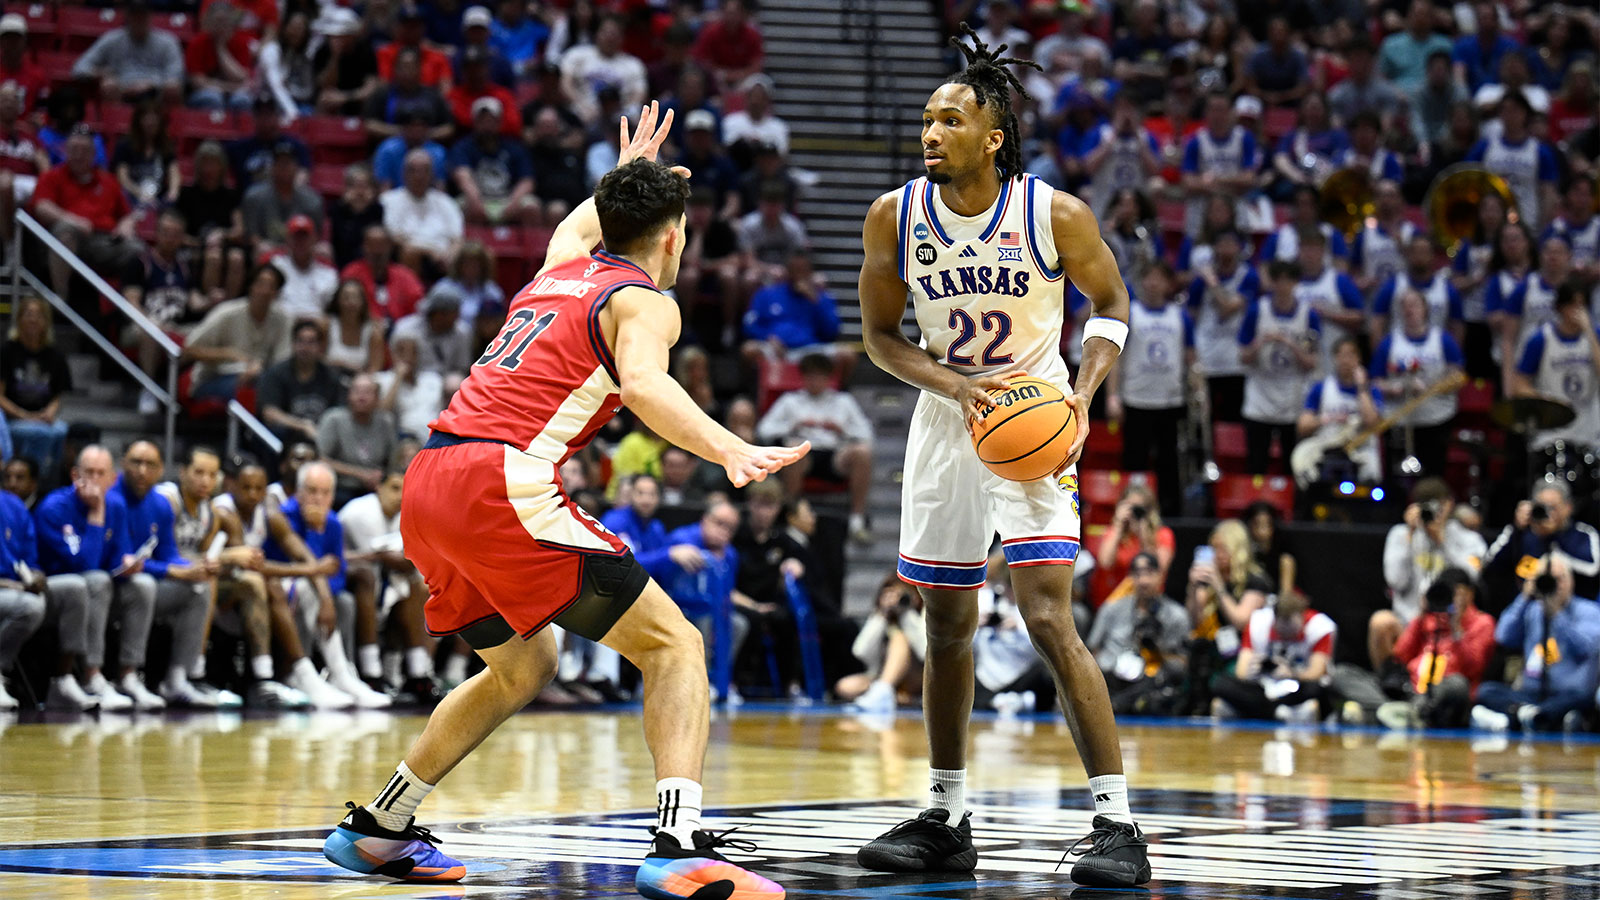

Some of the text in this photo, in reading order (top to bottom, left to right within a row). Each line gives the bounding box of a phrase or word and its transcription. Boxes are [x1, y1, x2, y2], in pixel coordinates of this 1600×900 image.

[918, 248, 934, 261] SW
[916, 265, 1030, 301] KANSAS
[474, 308, 559, 372] 31
[947, 308, 1015, 366] 22
